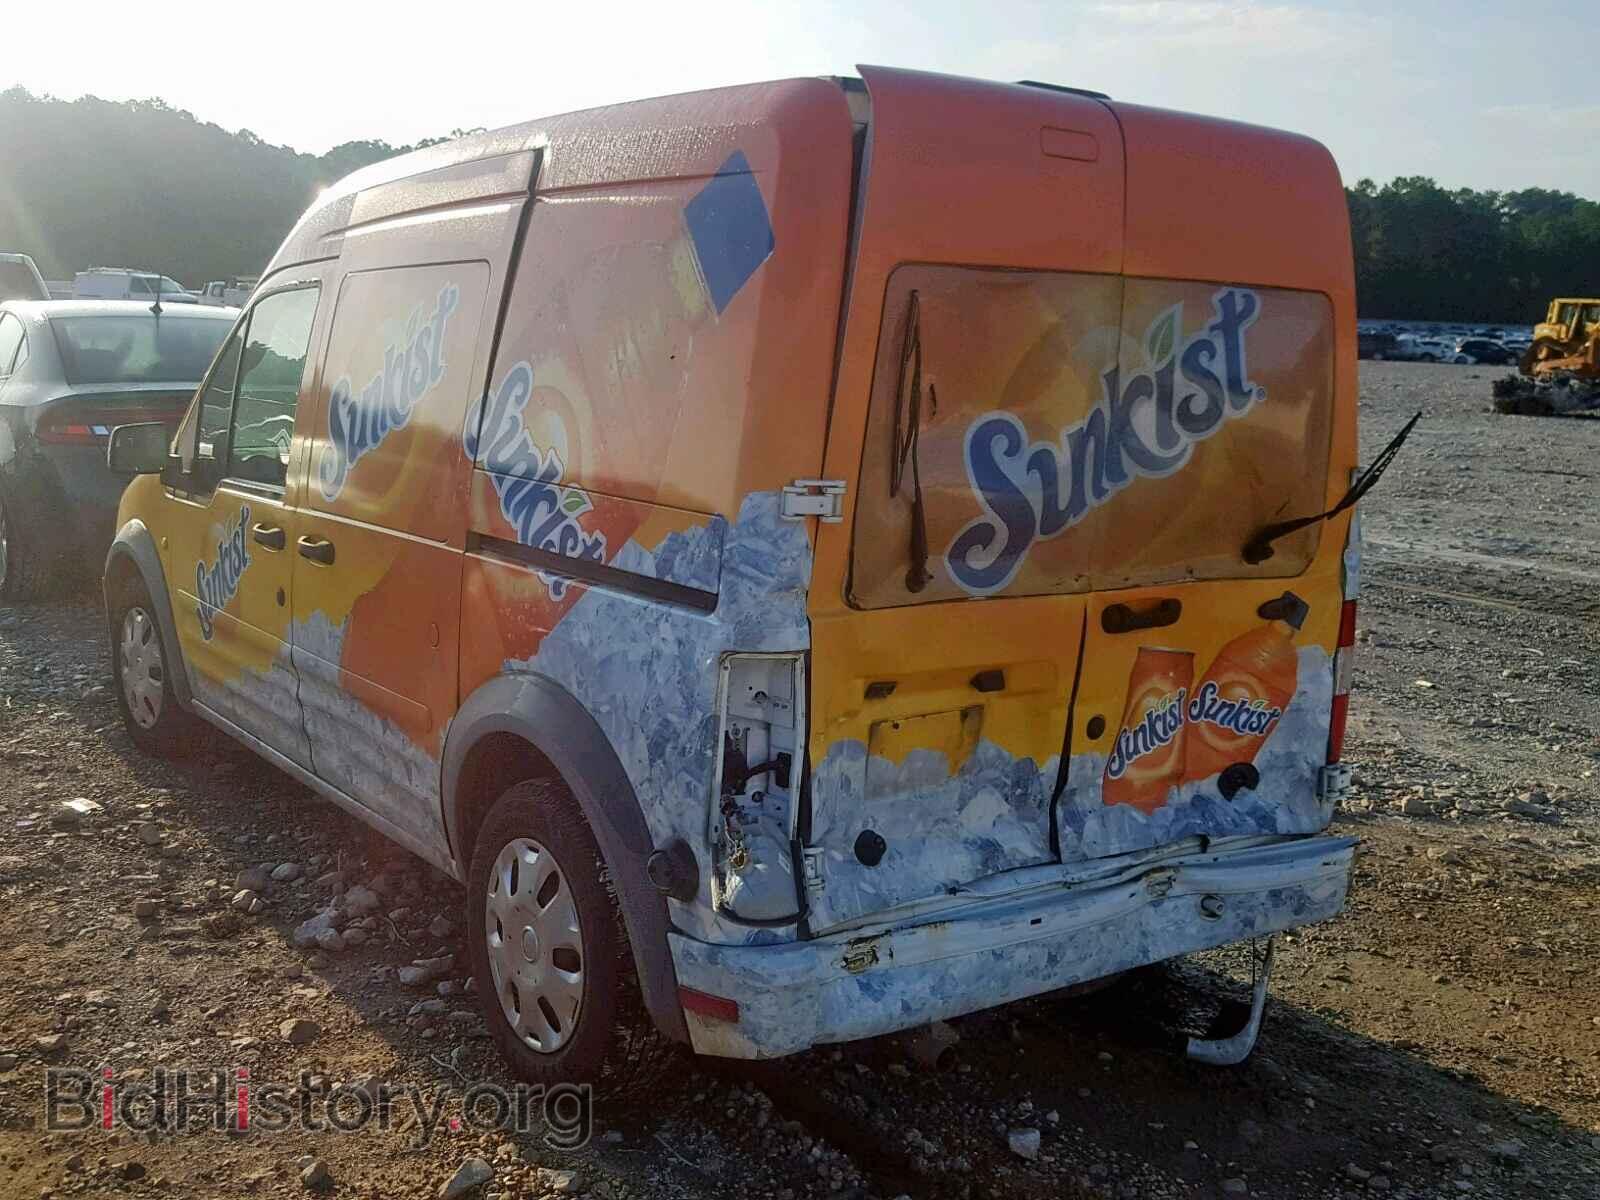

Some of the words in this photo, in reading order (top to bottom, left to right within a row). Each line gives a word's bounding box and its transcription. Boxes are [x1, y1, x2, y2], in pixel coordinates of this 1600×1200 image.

[319, 281, 459, 502] Sunkist
[945, 287, 1265, 596] Sunkist
[195, 502, 252, 642] Sunkist
[1107, 688, 1187, 779] Sunkist
[1188, 681, 1281, 735] Sunkist
